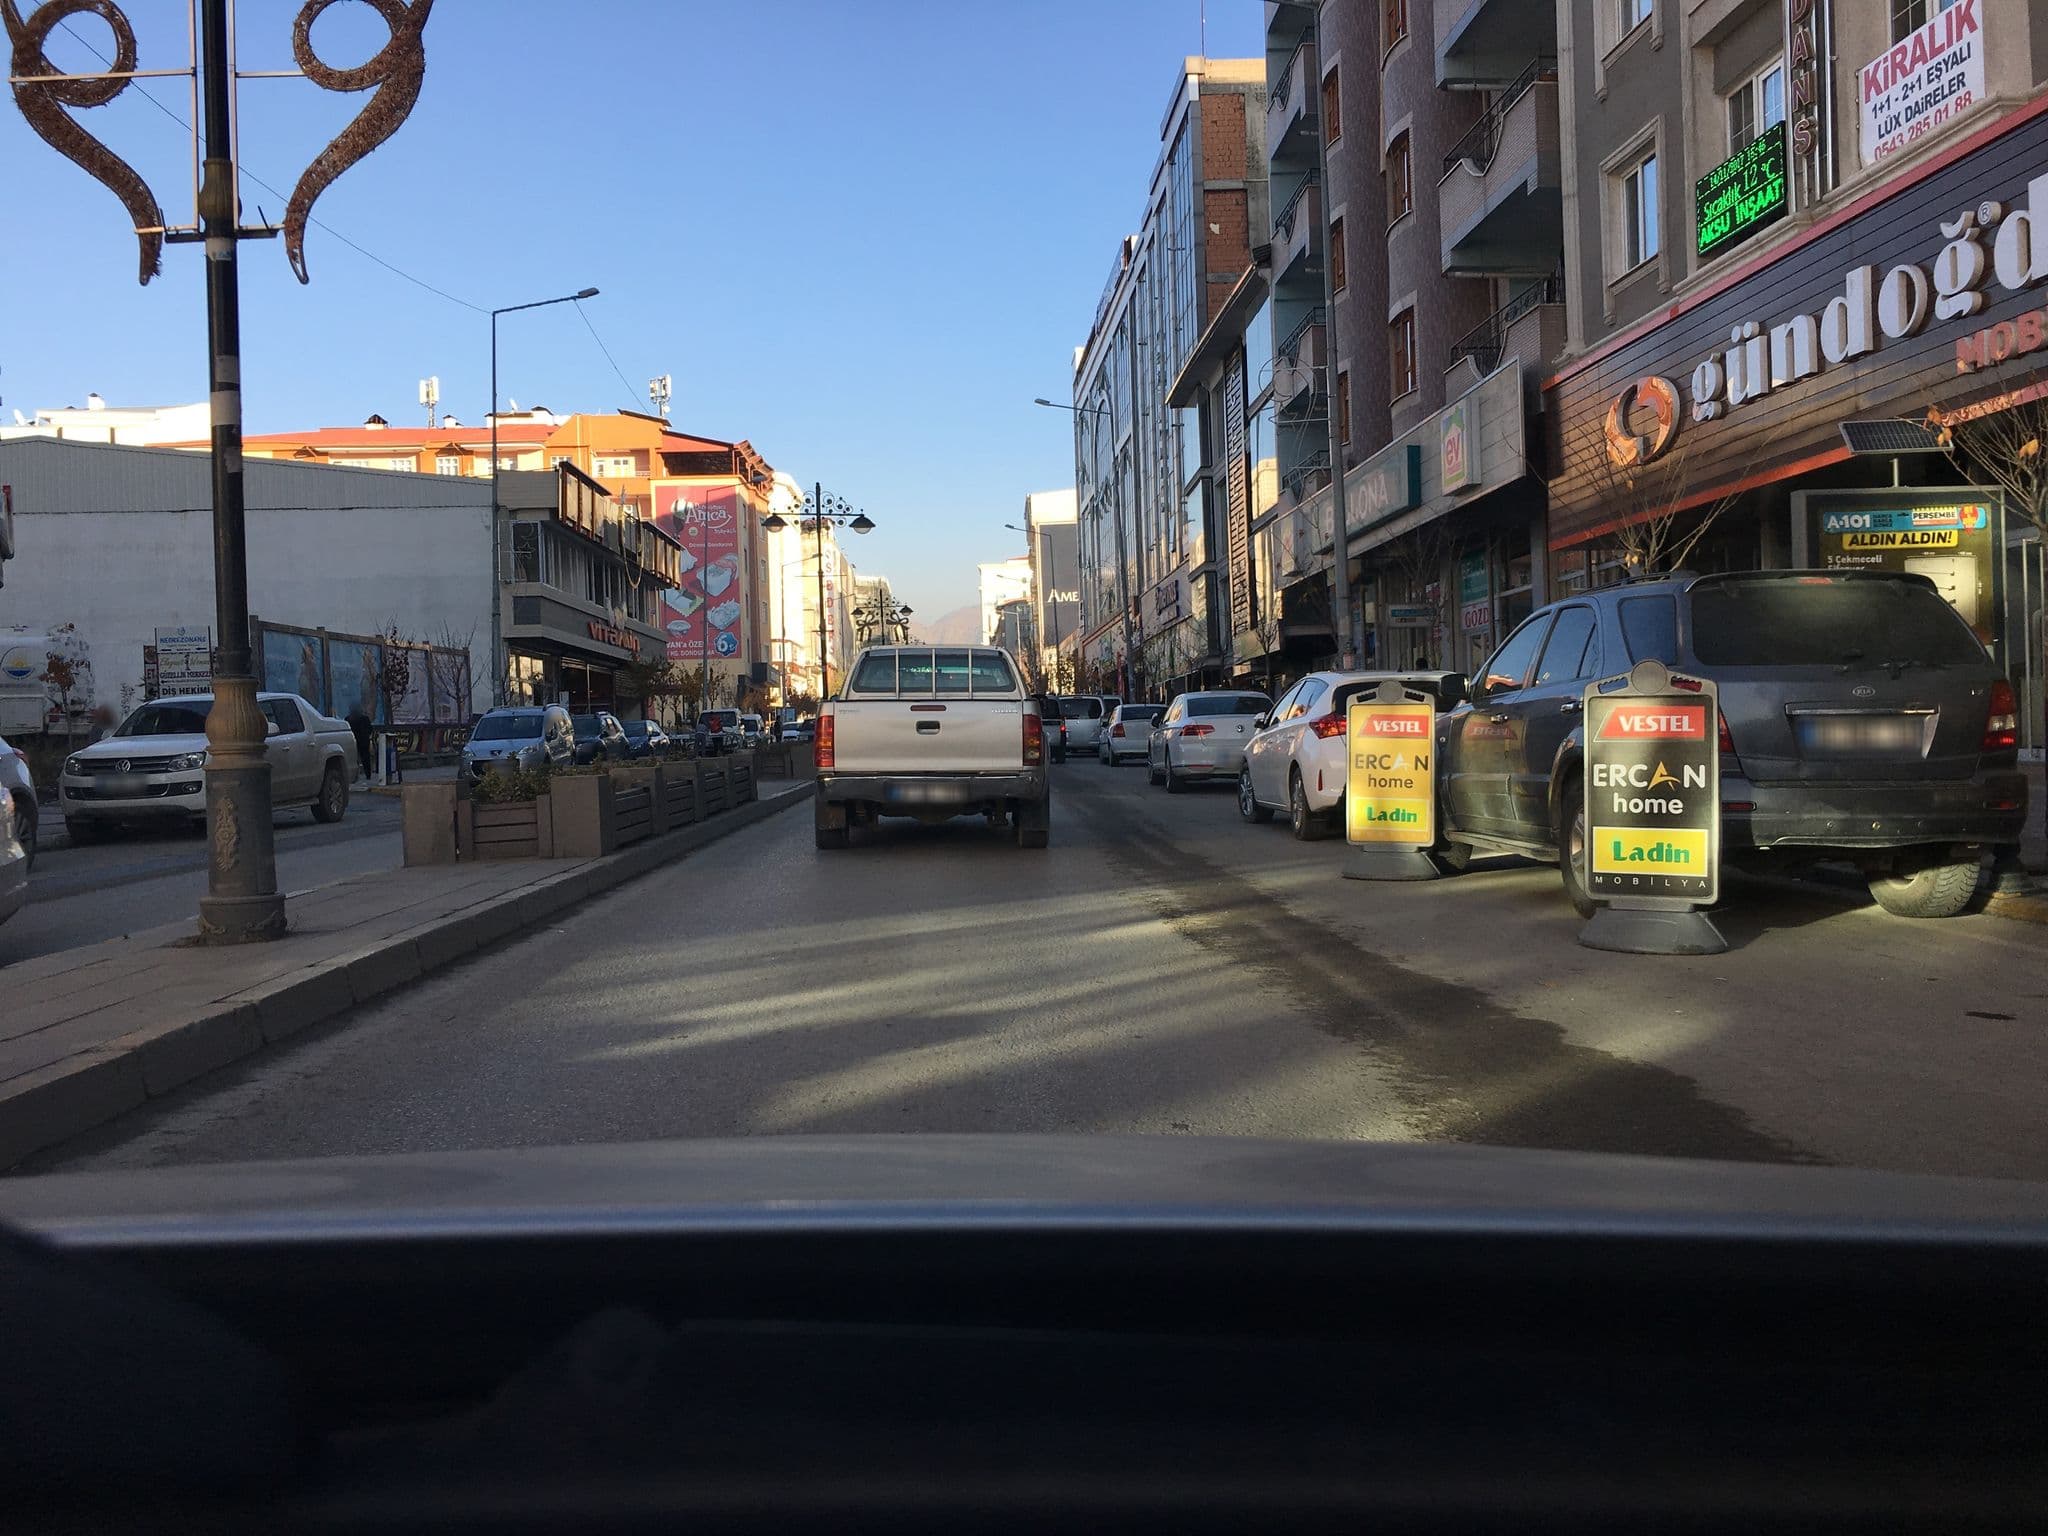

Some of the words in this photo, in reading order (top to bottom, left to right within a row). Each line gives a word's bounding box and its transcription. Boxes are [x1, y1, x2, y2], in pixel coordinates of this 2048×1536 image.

[1791, 0, 1813, 155] DANS
[1872, 94, 1891, 119] 1+1
[1902, 74, 1922, 101] 2+1
[1926, 41, 1972, 84] EŞYALI
[1874, 132, 1904, 160] 0543
[1907, 115, 1931, 143] 285
[1934, 103, 1950, 126] 01
[1954, 90, 1973, 114] 88
[1878, 109, 1902, 139] LÜX
[1743, 163, 1758, 192] 12
[1700, 211, 1731, 248] AKSU
[1956, 308, 2048, 375] MOB
[1326, 472, 1389, 534] BLONA
[1848, 532, 1897, 547] ALDIN
[1899, 530, 1953, 545] ALDIN!
[1373, 719, 1423, 733] VESTEL
[1618, 714, 1695, 732] VESTEL
[1354, 752, 1429, 774] ERCAN
[1593, 761, 1706, 791] ERCAN
[1367, 774, 1414, 789] home
[1367, 806, 1418, 823] Ladin
[1613, 792, 1684, 814] home
[1613, 840, 1690, 864] Ladin
